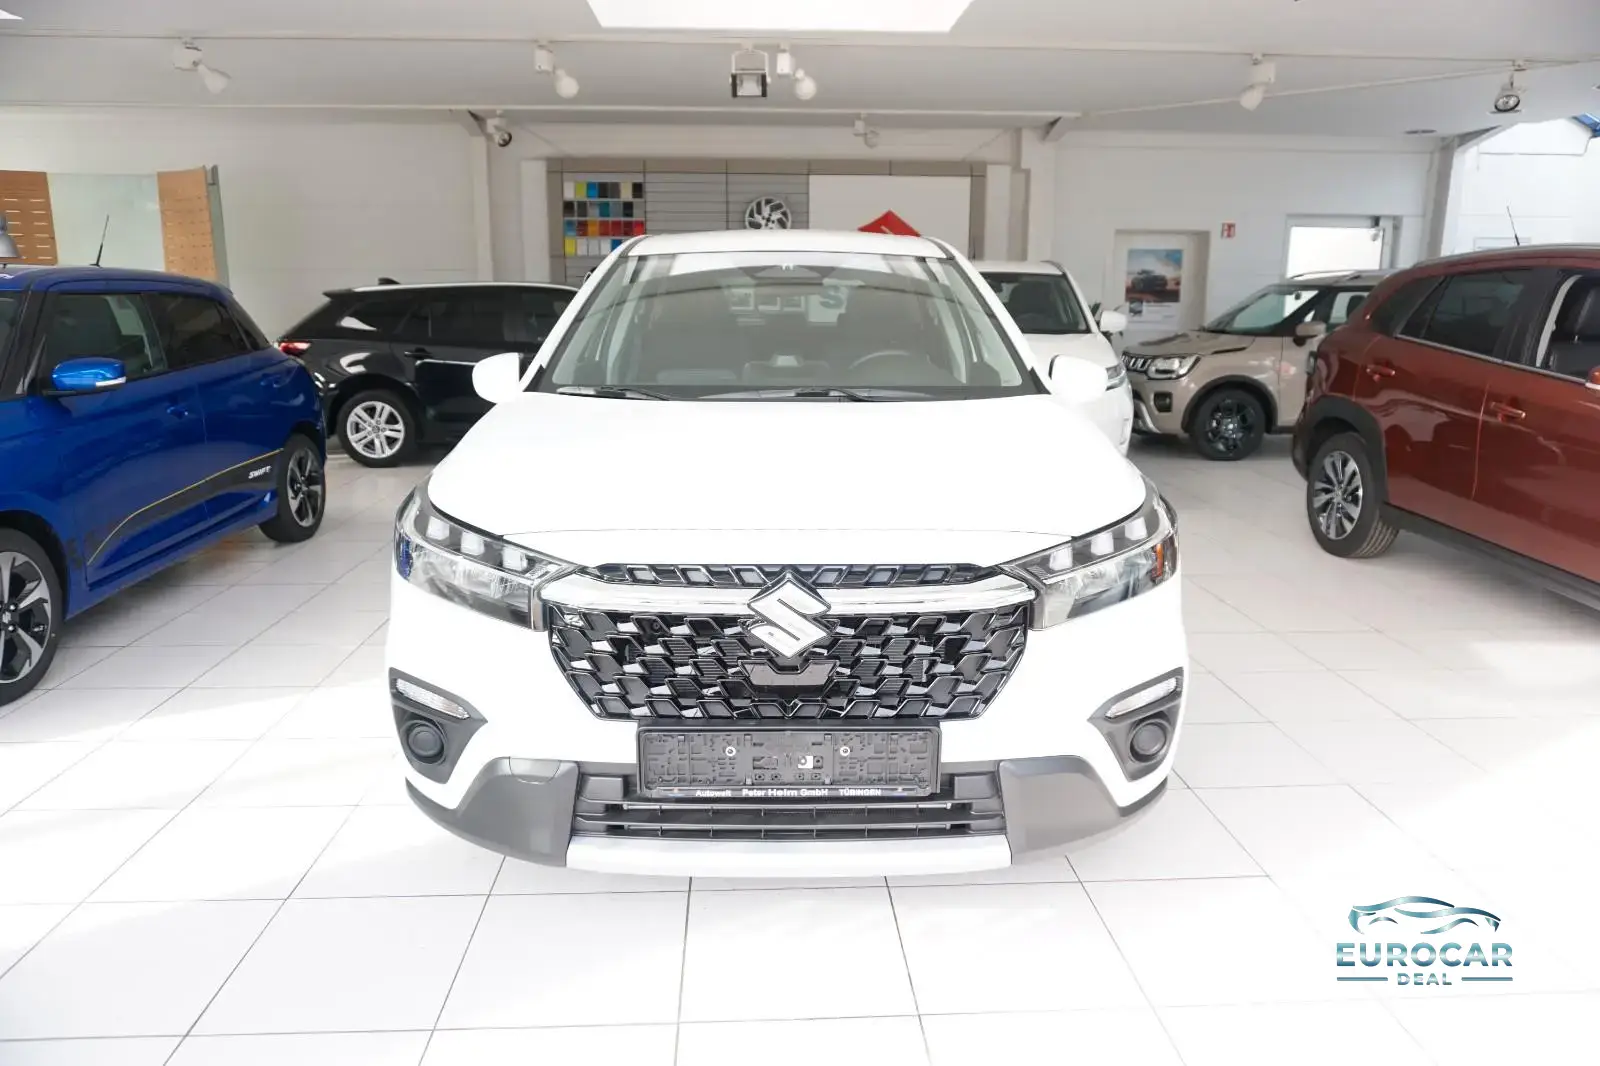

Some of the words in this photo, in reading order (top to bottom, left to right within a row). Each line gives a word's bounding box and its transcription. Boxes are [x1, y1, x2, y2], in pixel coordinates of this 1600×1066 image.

[248, 465, 272, 479] SWIFT
[695, 789, 732, 797] Autowelt
[742, 788, 766, 797] Peter
[800, 788, 829, 797] GmbH
[838, 787, 882, 797] TÜBINGEN
